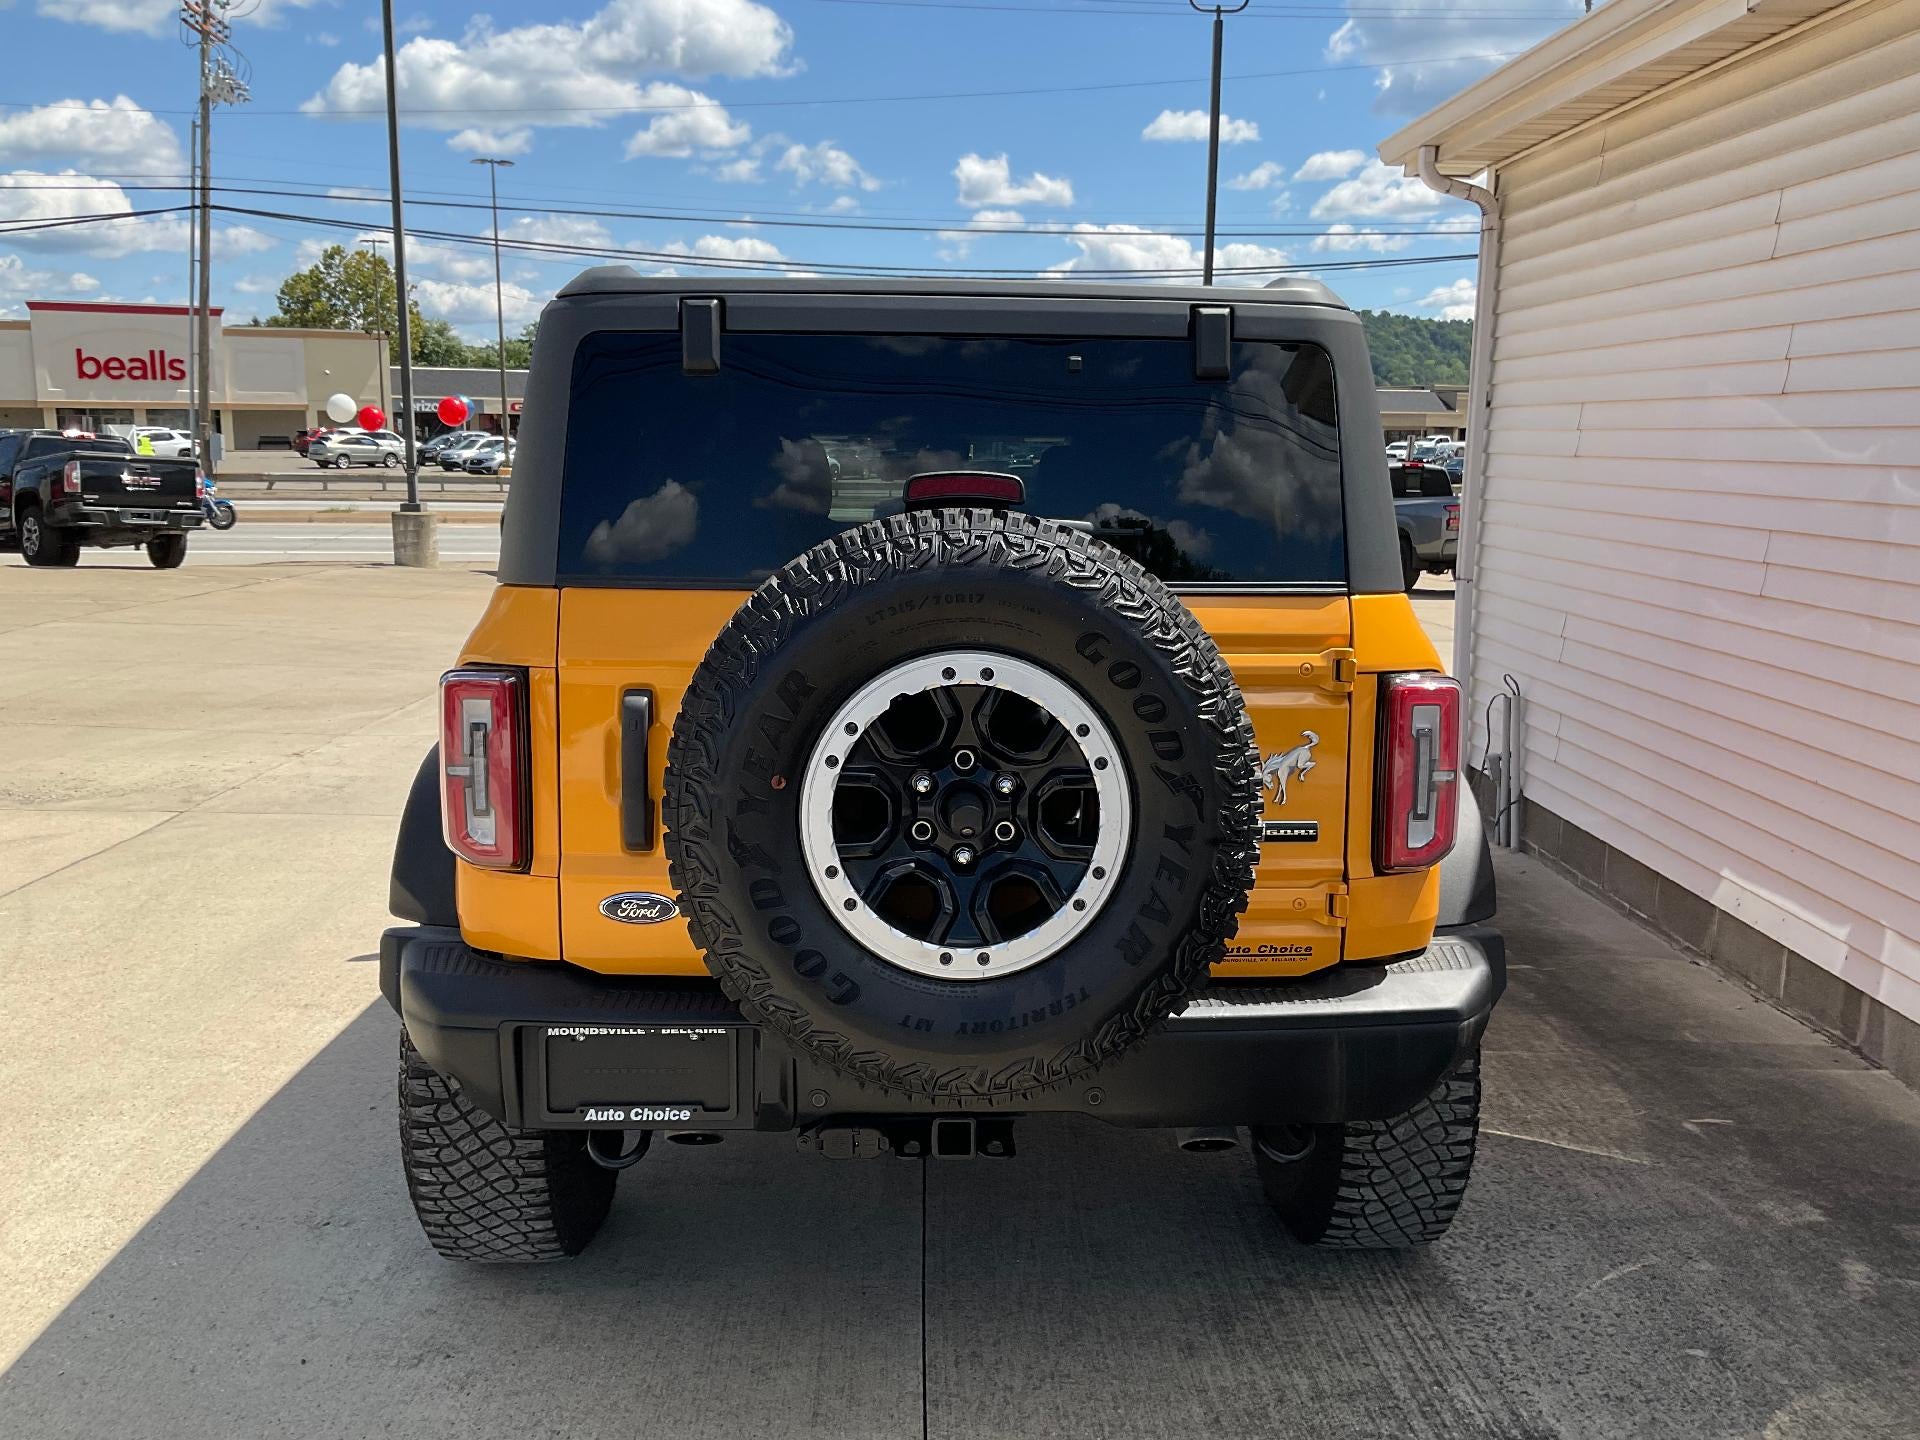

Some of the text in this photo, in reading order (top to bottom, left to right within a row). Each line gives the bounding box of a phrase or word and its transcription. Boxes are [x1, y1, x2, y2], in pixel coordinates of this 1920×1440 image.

[76, 348, 187, 381] bealls
[1075, 631, 1199, 969] GOODYEAR
[733, 669, 860, 1004] GOODYEAR
[617, 899, 661, 918] Ford
[1225, 943, 1313, 954] uto Choice
[898, 987, 1091, 1036] TERRITORY MT
[547, 1027, 646, 1036] MOUNDSVILLE
[583, 1107, 691, 1121] Auto Choice
